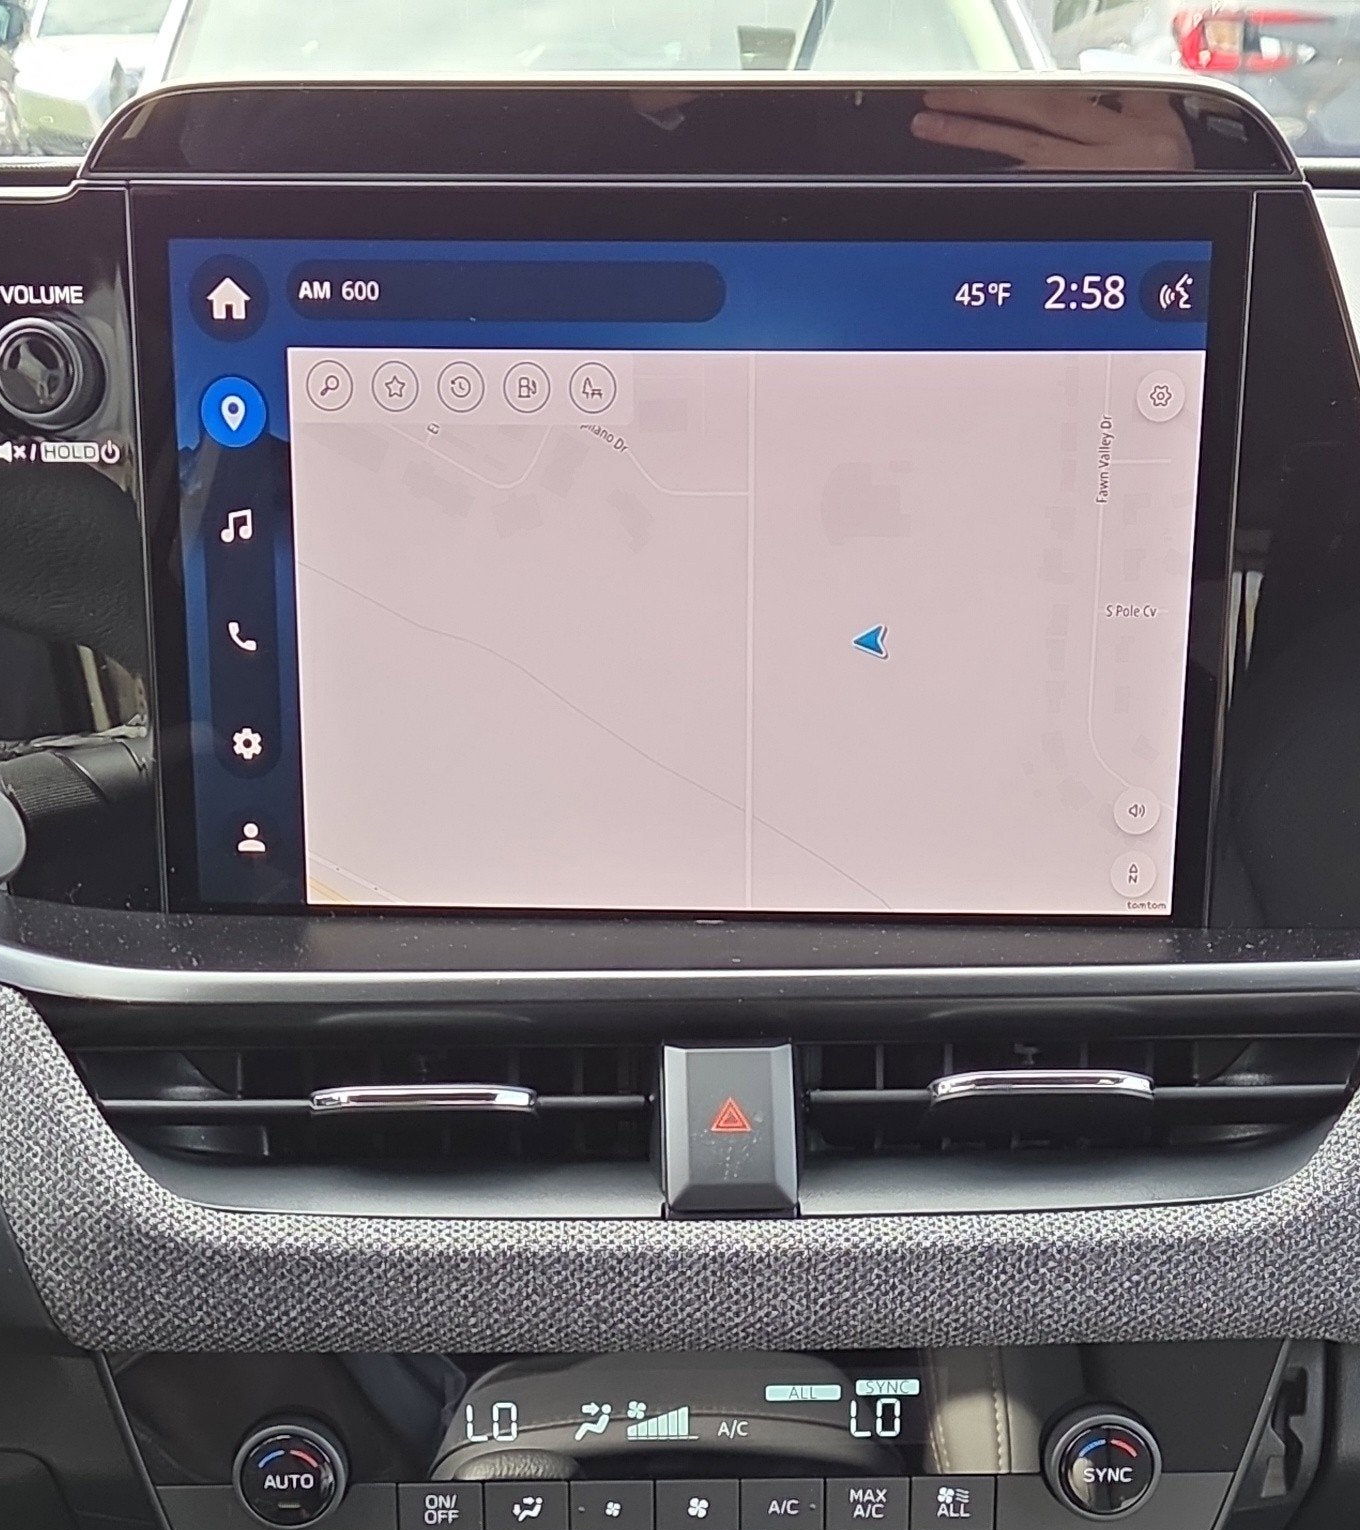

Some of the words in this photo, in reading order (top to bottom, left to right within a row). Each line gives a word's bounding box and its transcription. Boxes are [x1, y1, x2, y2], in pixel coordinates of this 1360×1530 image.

[298, 281, 331, 300] AM
[341, 280, 380, 301] 600
[954, 282, 1012, 307] 45°F
[1043, 275, 1126, 310] 2:58
[1101, 415, 1112, 429] Dr
[44, 444, 97, 460] HOLD
[614, 437, 629, 453] Dr
[1098, 430, 1115, 469] Valley
[1096, 469, 1109, 503] Fawn
[1115, 604, 1140, 618] Pole
[1127, 901, 1167, 910] tomtom
[788, 1386, 819, 1400] ALL
[865, 1380, 911, 1395] SYNC
[465, 1402, 518, 1443] LO
[849, 1397, 902, 1438] LO
[717, 1419, 749, 1440] A/C
[263, 1473, 315, 1490] AUTO
[1082, 1467, 1133, 1484] SYNC
[424, 1494, 458, 1510] ON/
[849, 1488, 888, 1504] MAX
[767, 1498, 800, 1516] A/C
[853, 1503, 886, 1519] A/C
[937, 1503, 971, 1519] ALL
[424, 1510, 460, 1525] OFF
